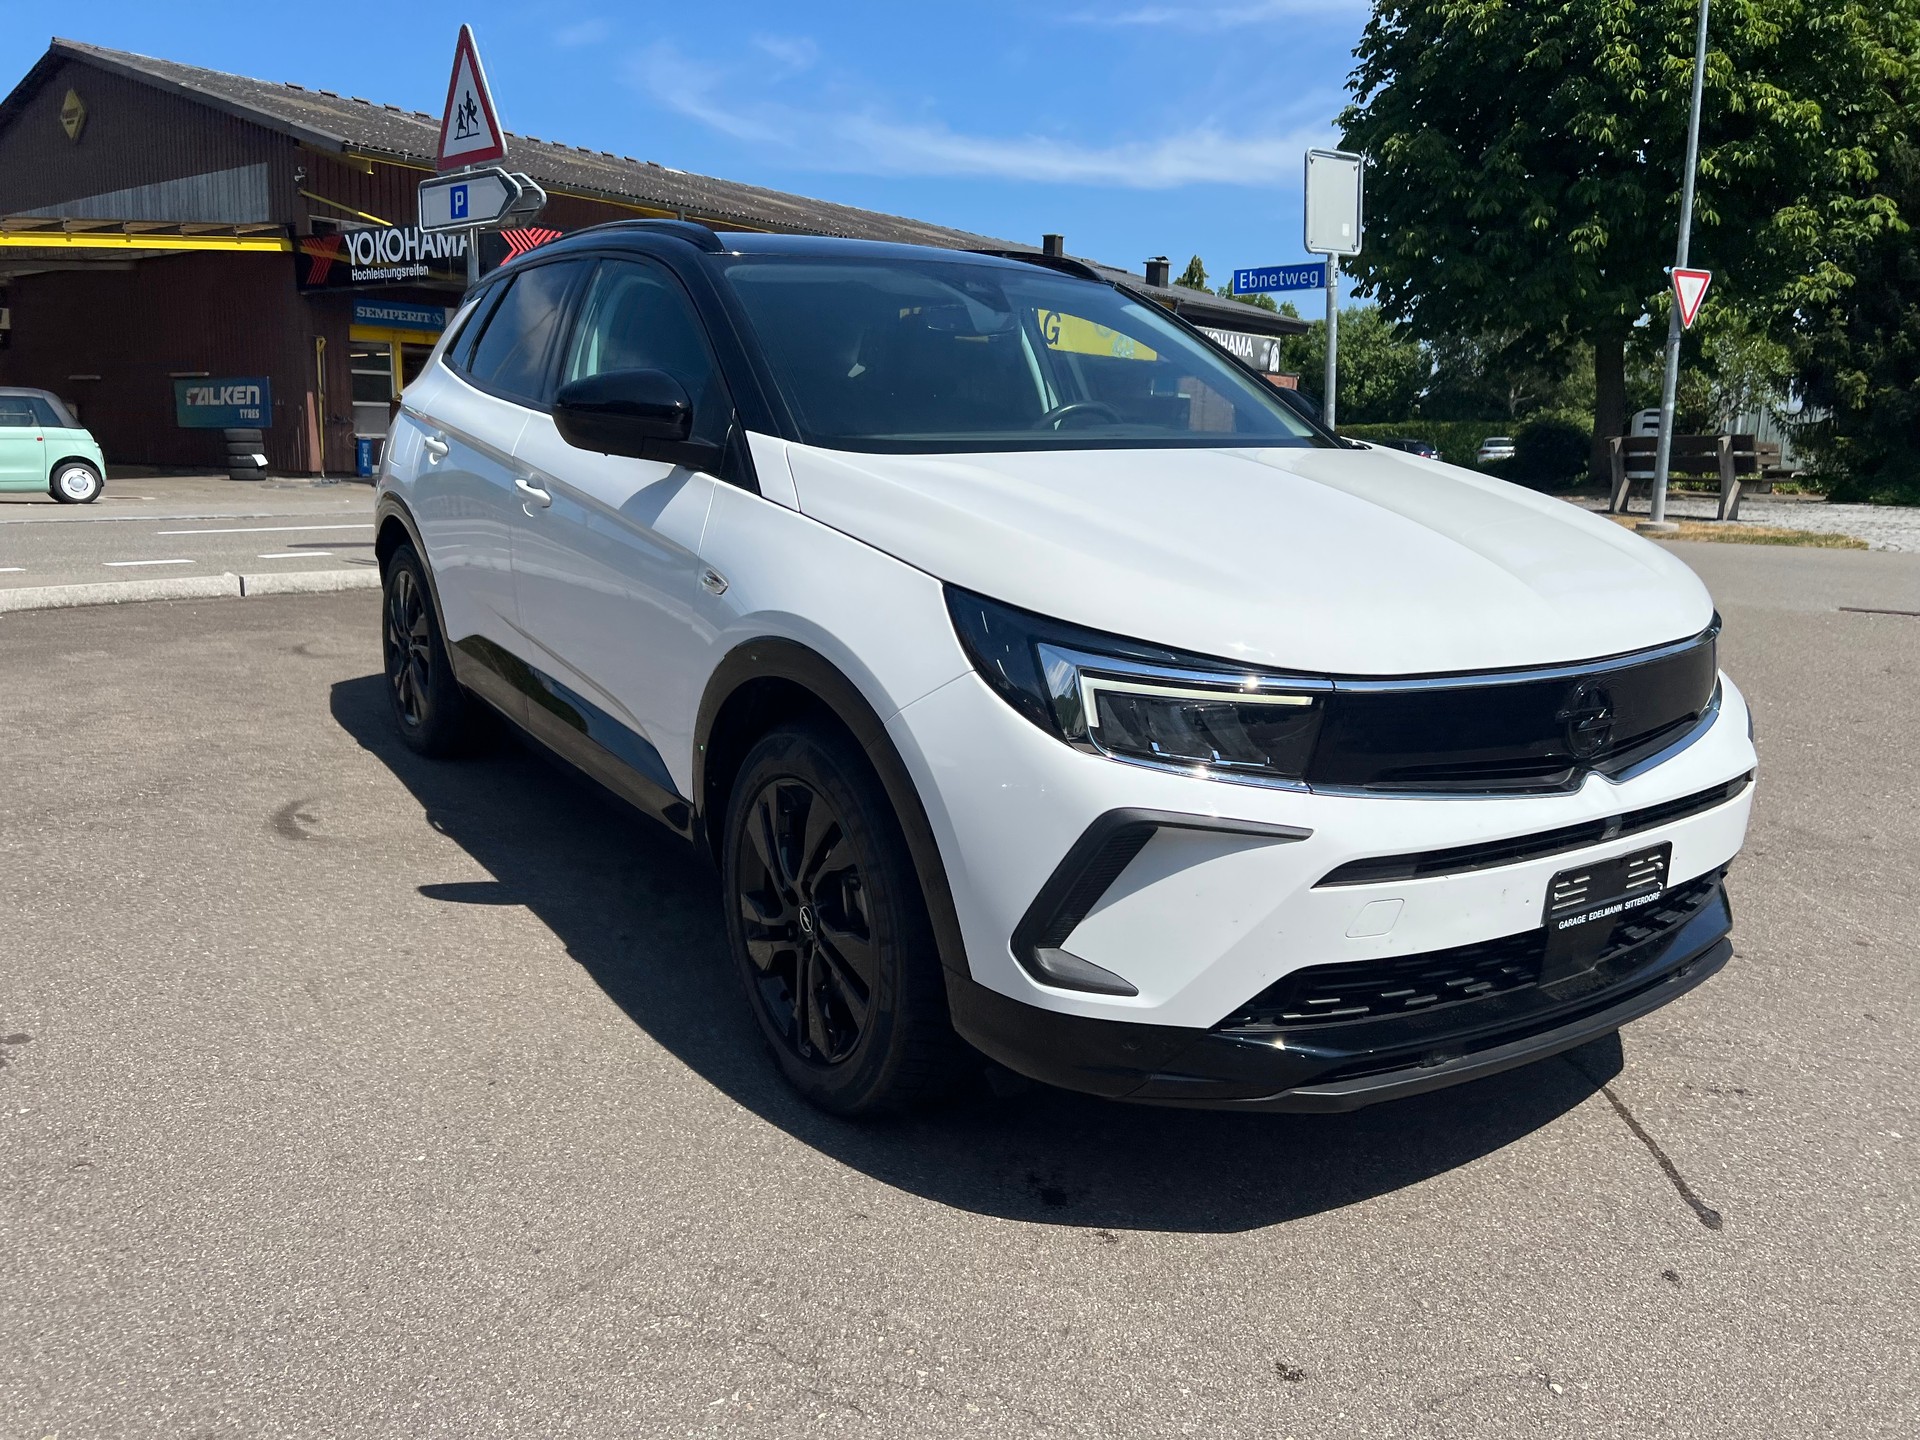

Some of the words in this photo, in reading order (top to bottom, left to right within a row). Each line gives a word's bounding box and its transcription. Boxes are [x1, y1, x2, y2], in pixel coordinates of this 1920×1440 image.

[454, 190, 464, 215] P
[351, 264, 429, 281] Hochleistungsreifen
[1239, 270, 1319, 289] Ebnetweg
[356, 306, 431, 323] SEMPERIT
[186, 385, 260, 405] FALKEN
[240, 408, 260, 419] TYRES
[1558, 914, 1587, 930] GARAGE
[1588, 903, 1623, 921] EDELMANN
[1624, 891, 1661, 910] SITTERDORF
